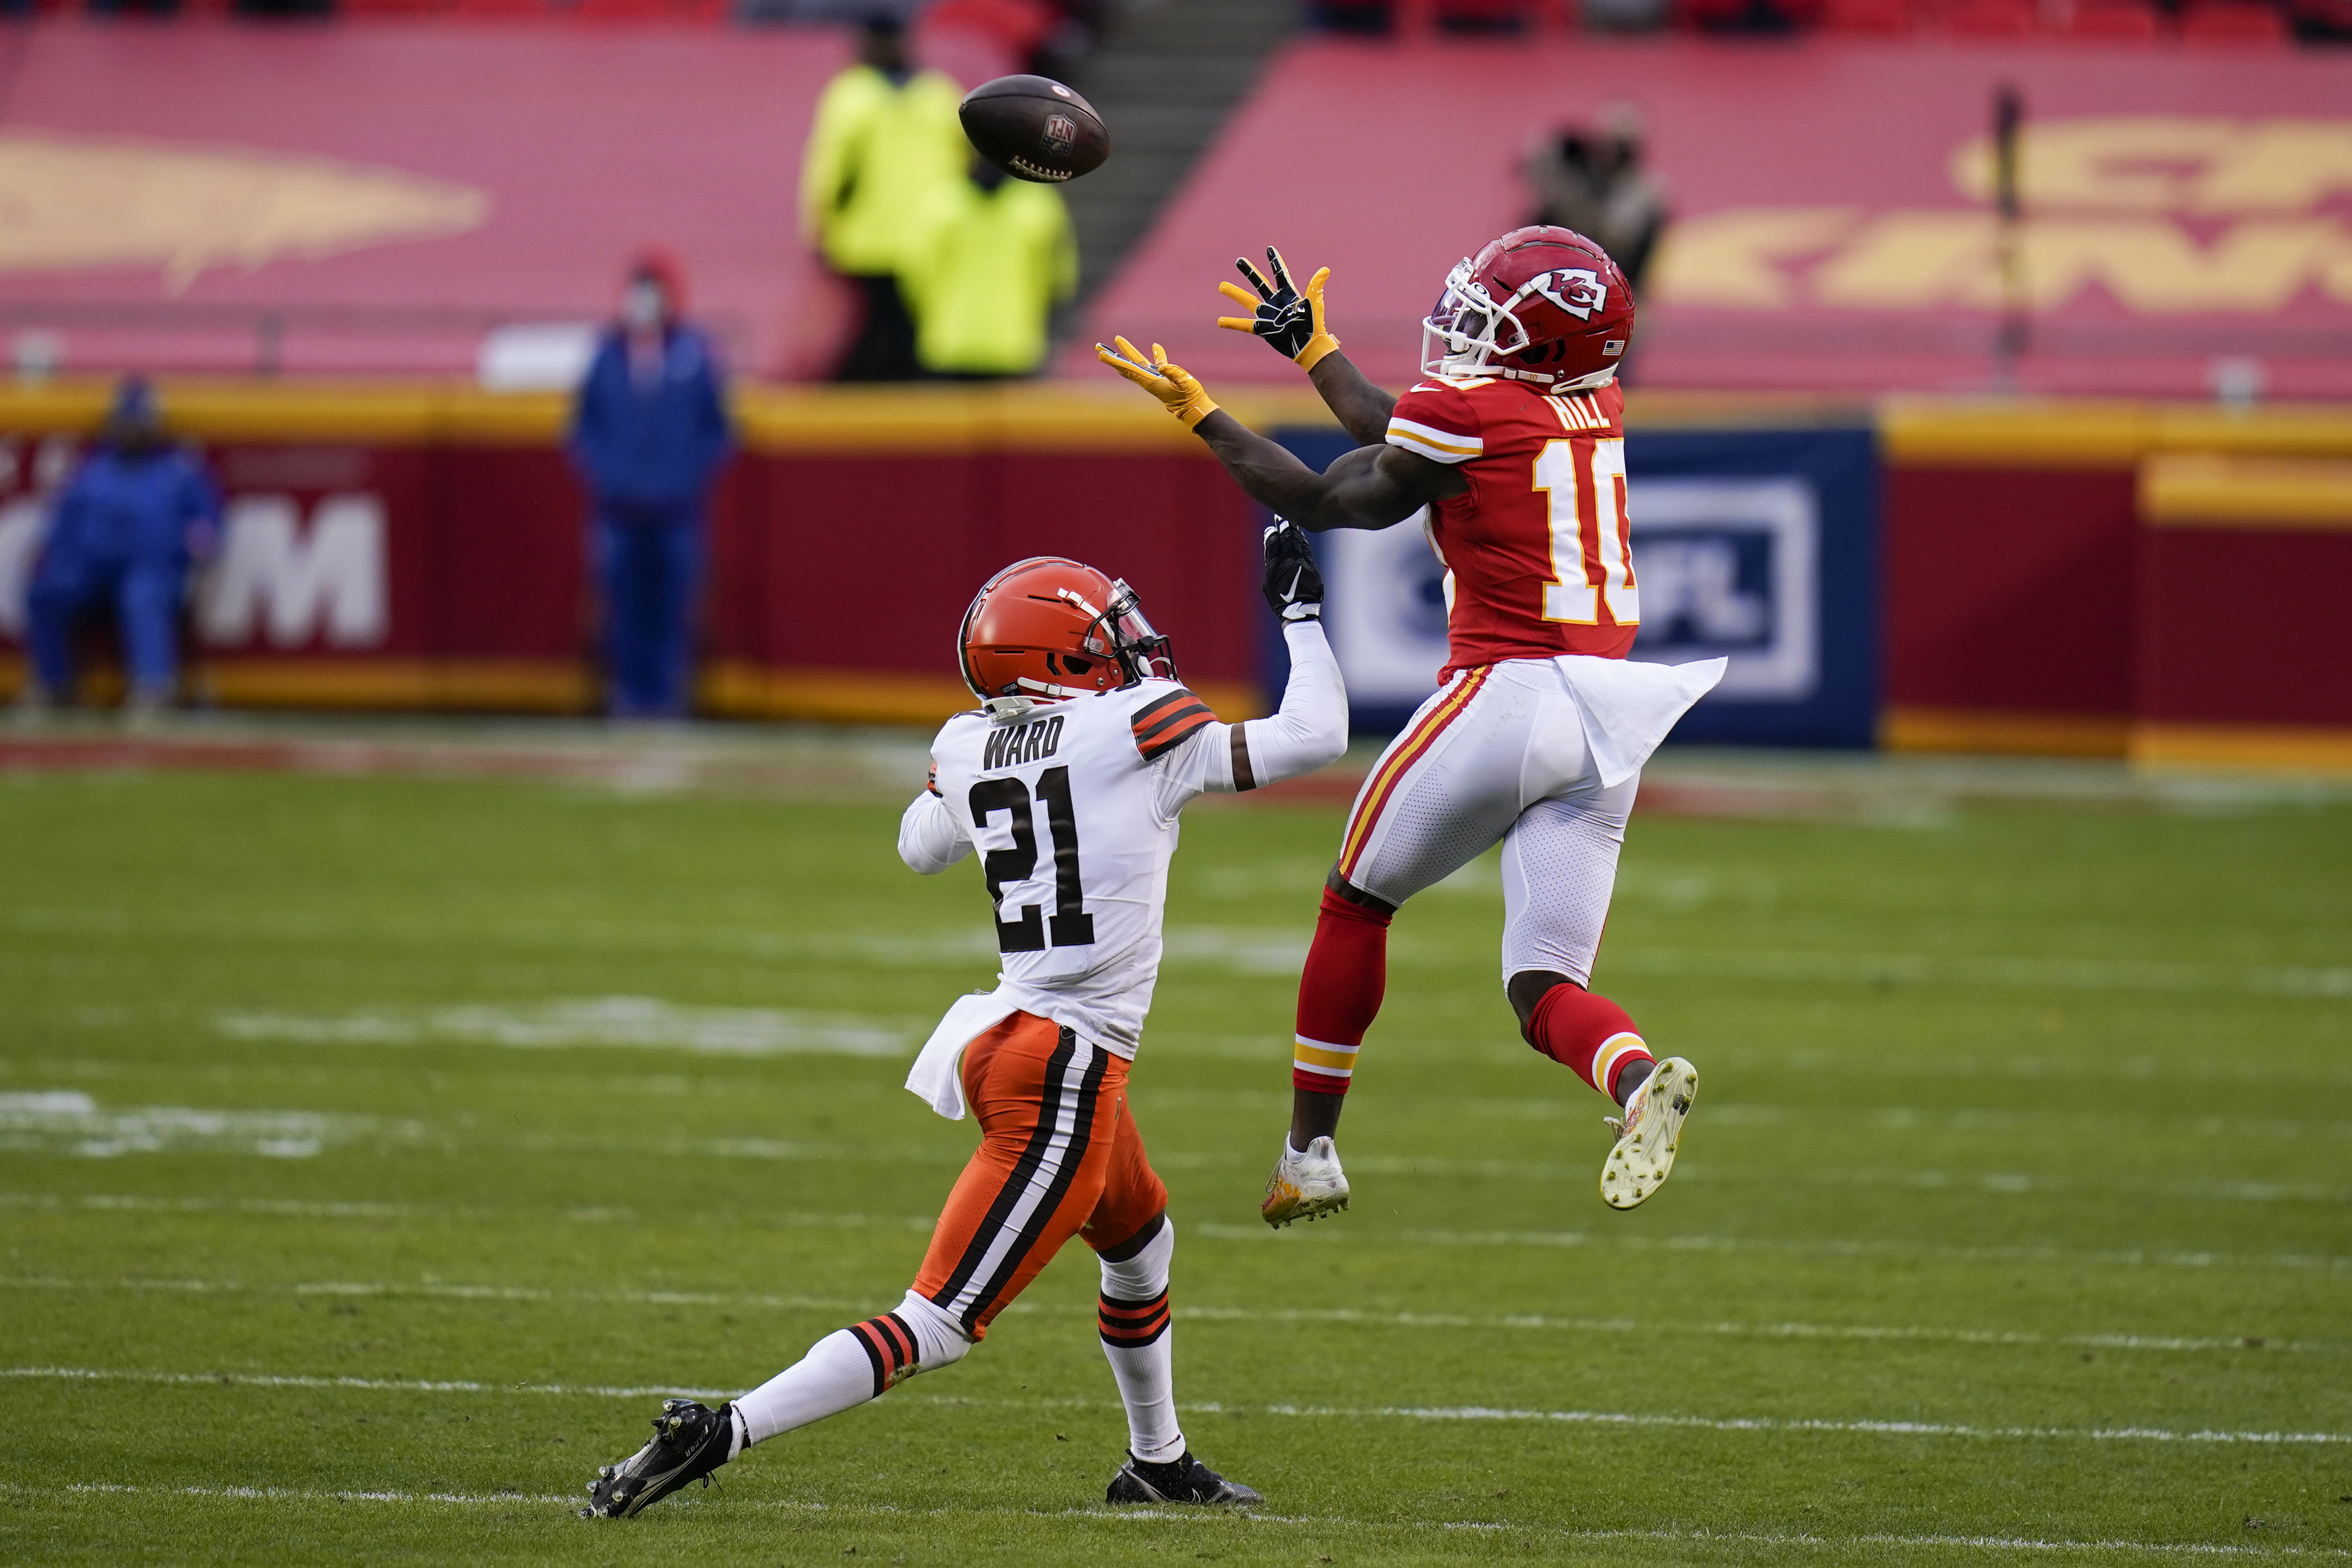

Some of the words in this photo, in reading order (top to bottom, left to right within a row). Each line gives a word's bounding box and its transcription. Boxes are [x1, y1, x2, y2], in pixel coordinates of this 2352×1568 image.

[1051, 119, 1074, 141] NFL
[1547, 272, 1598, 308] KC
[1541, 390, 1611, 431] HILL
[1532, 437, 1640, 625] 10
[984, 716, 1064, 770] WARD
[969, 765, 1095, 953] 21
[684, 1424, 709, 1457] VAPOR
